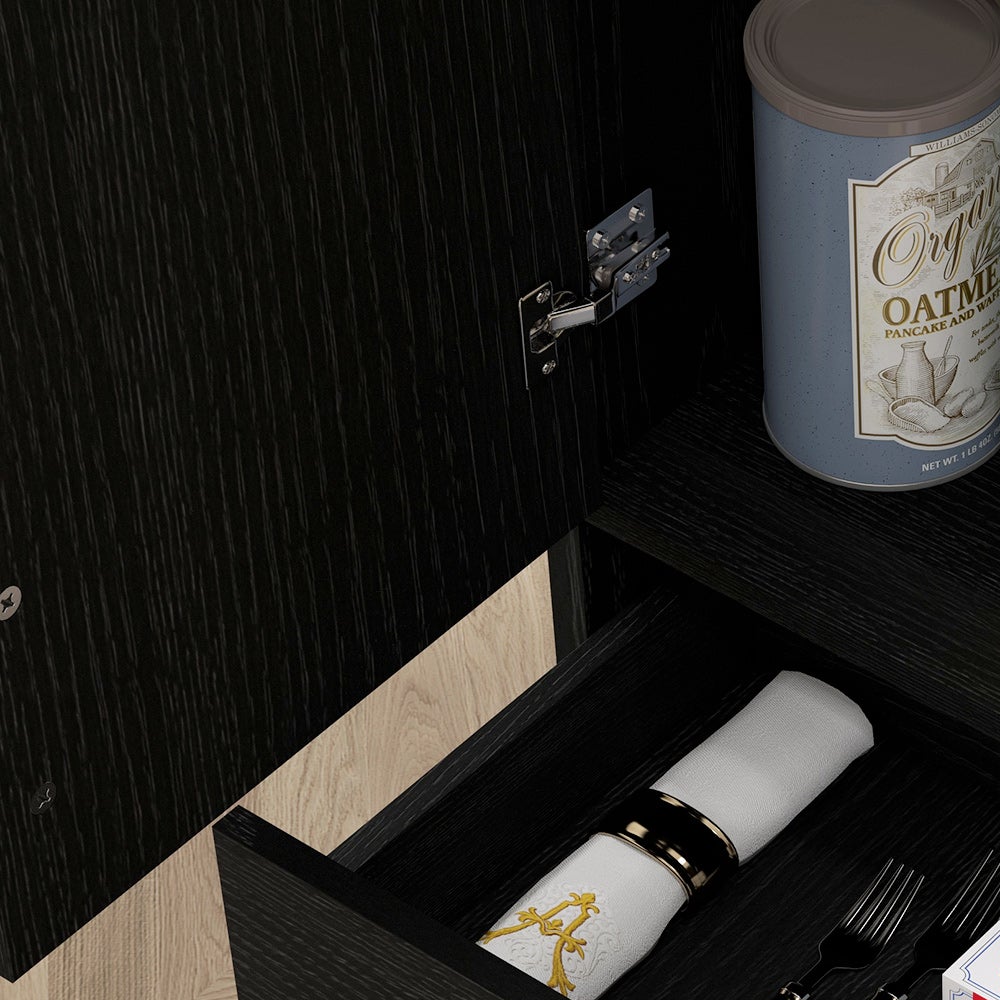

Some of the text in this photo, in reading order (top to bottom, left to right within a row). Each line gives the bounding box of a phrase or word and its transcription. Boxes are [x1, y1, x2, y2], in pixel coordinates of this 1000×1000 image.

[884, 320, 947, 339] PANCAKE
[950, 308, 975, 328] AND
[921, 461, 941, 473] NET
[942, 454, 960, 467] WT.
[967, 444, 978, 456] LB
